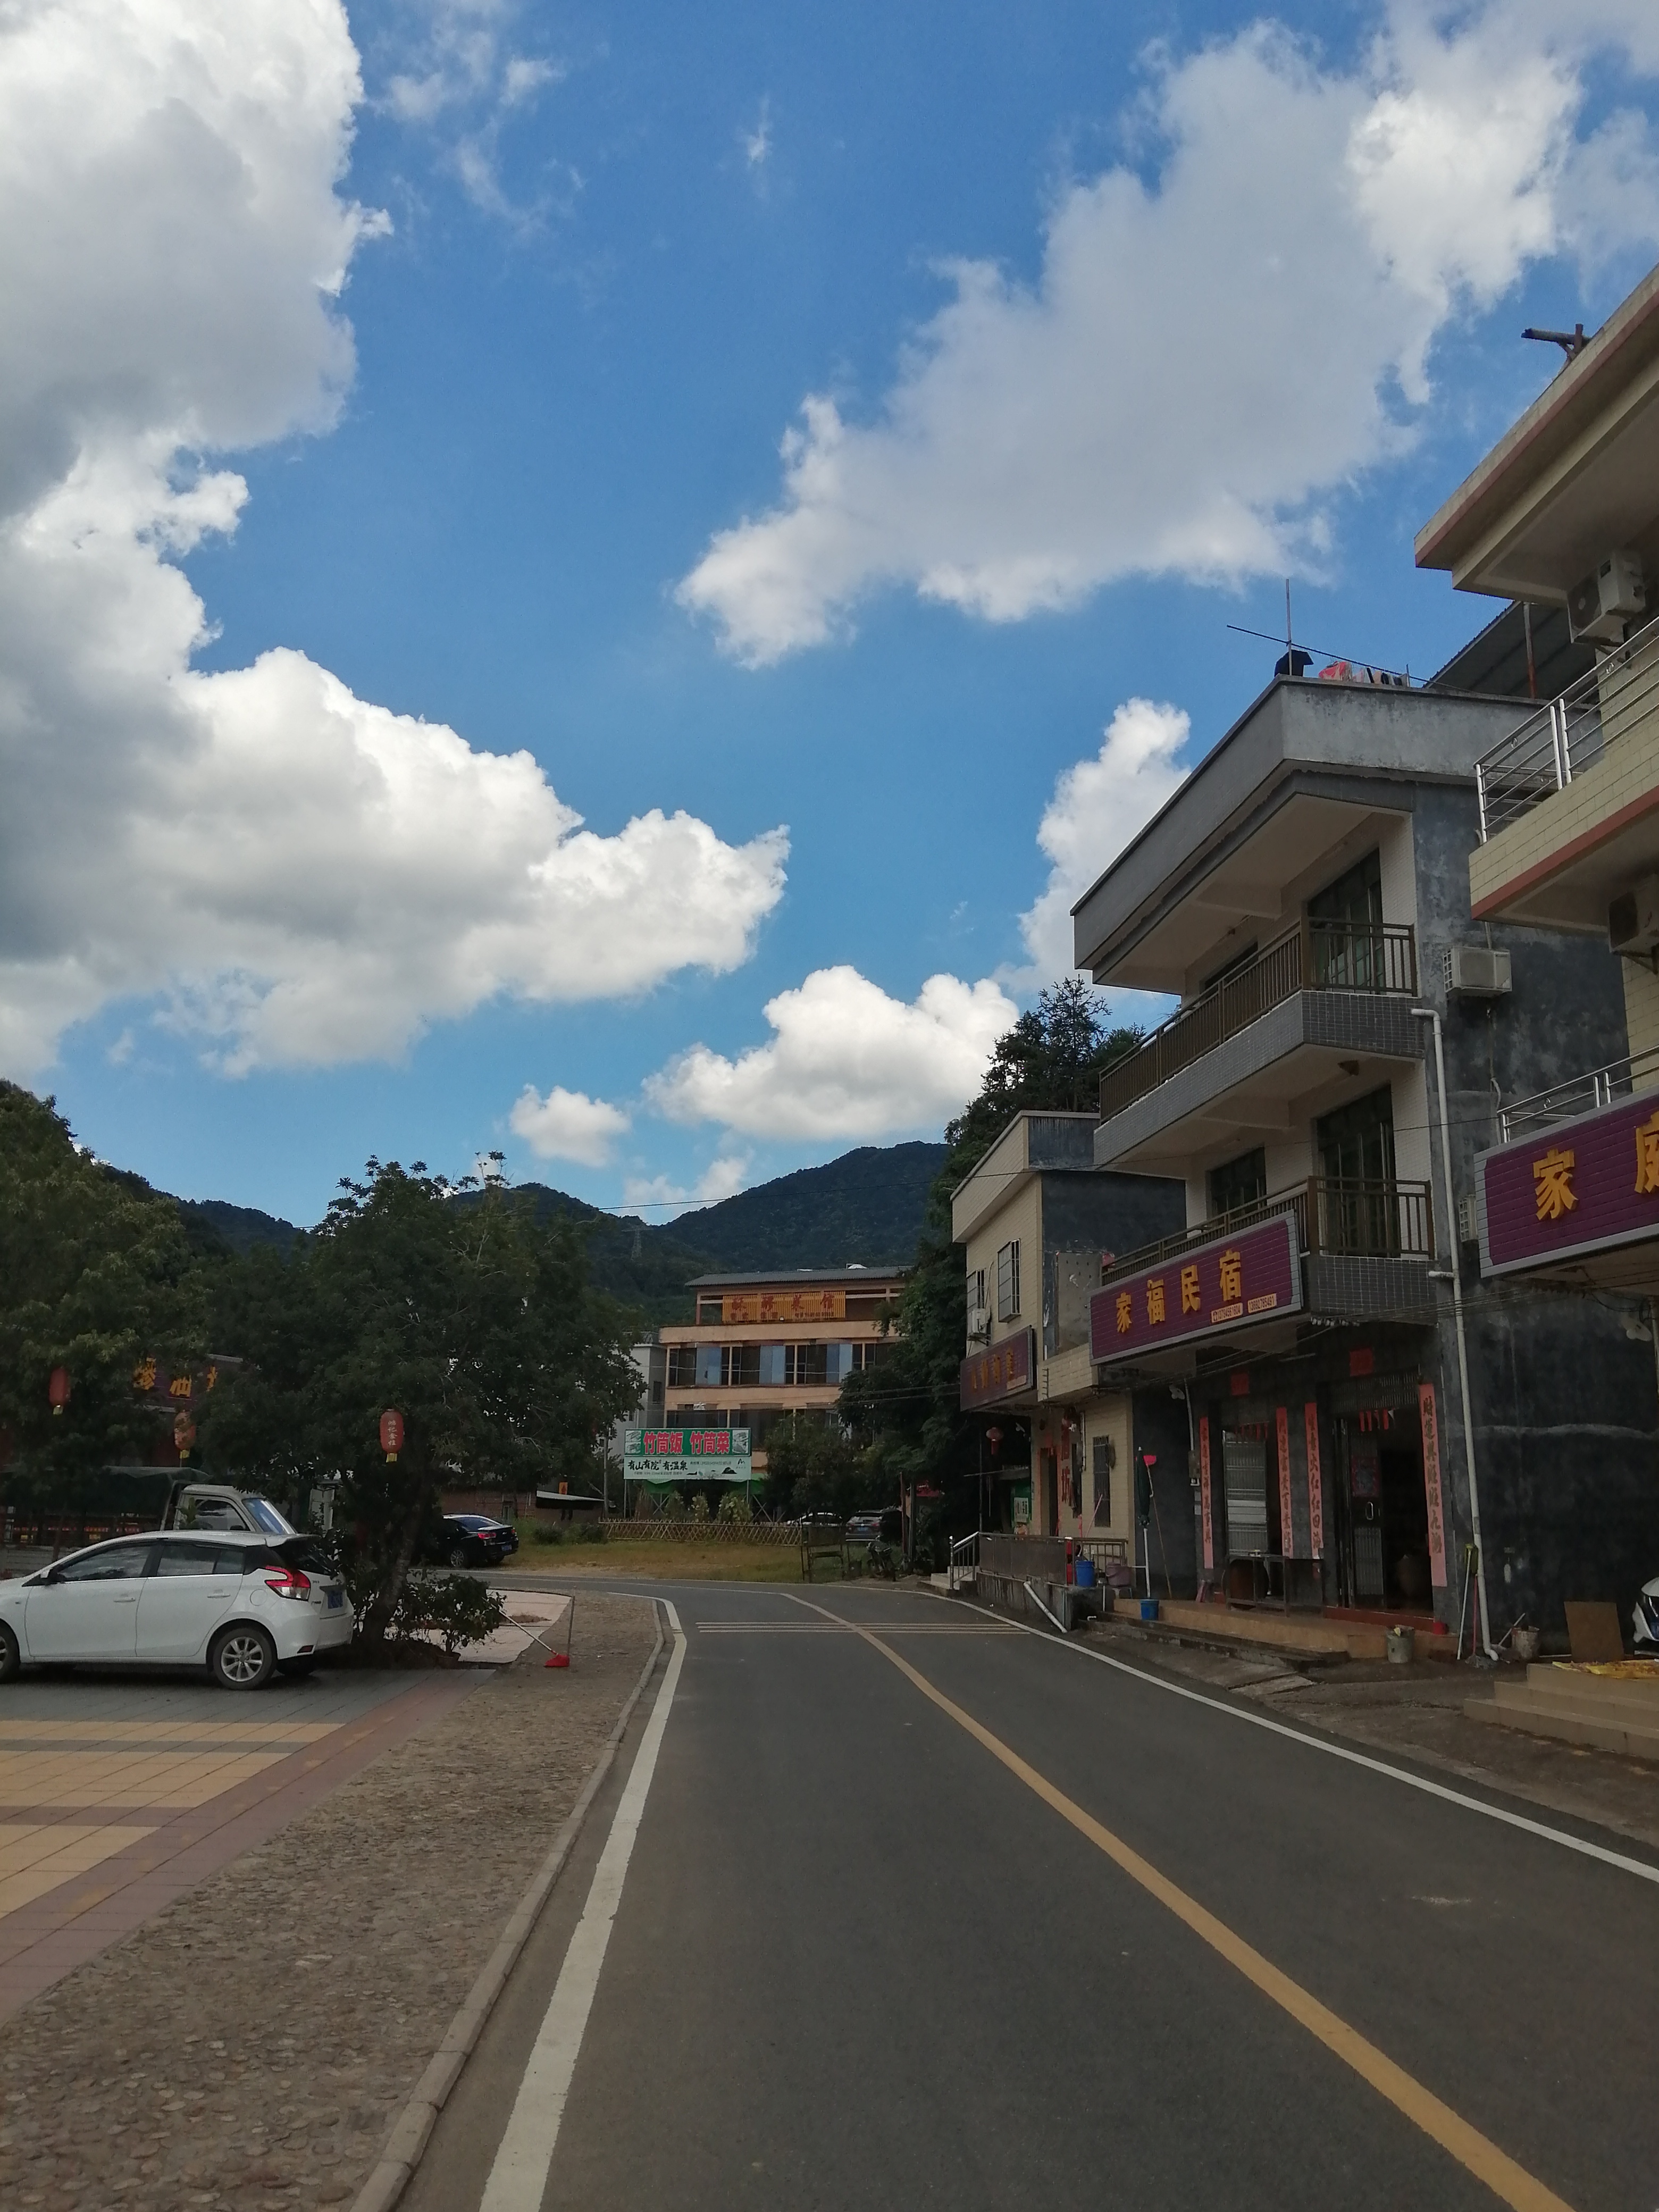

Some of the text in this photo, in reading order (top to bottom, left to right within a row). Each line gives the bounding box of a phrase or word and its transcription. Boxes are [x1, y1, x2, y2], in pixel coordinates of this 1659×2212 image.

[1116, 1249, 1242, 1333] 家福民宿
[643, 1430, 731, 1454] 竹筒饭 竹筒菜
[627, 1459, 659, 1470] 有山有院
[663, 1460, 688, 1471] 有温泉
